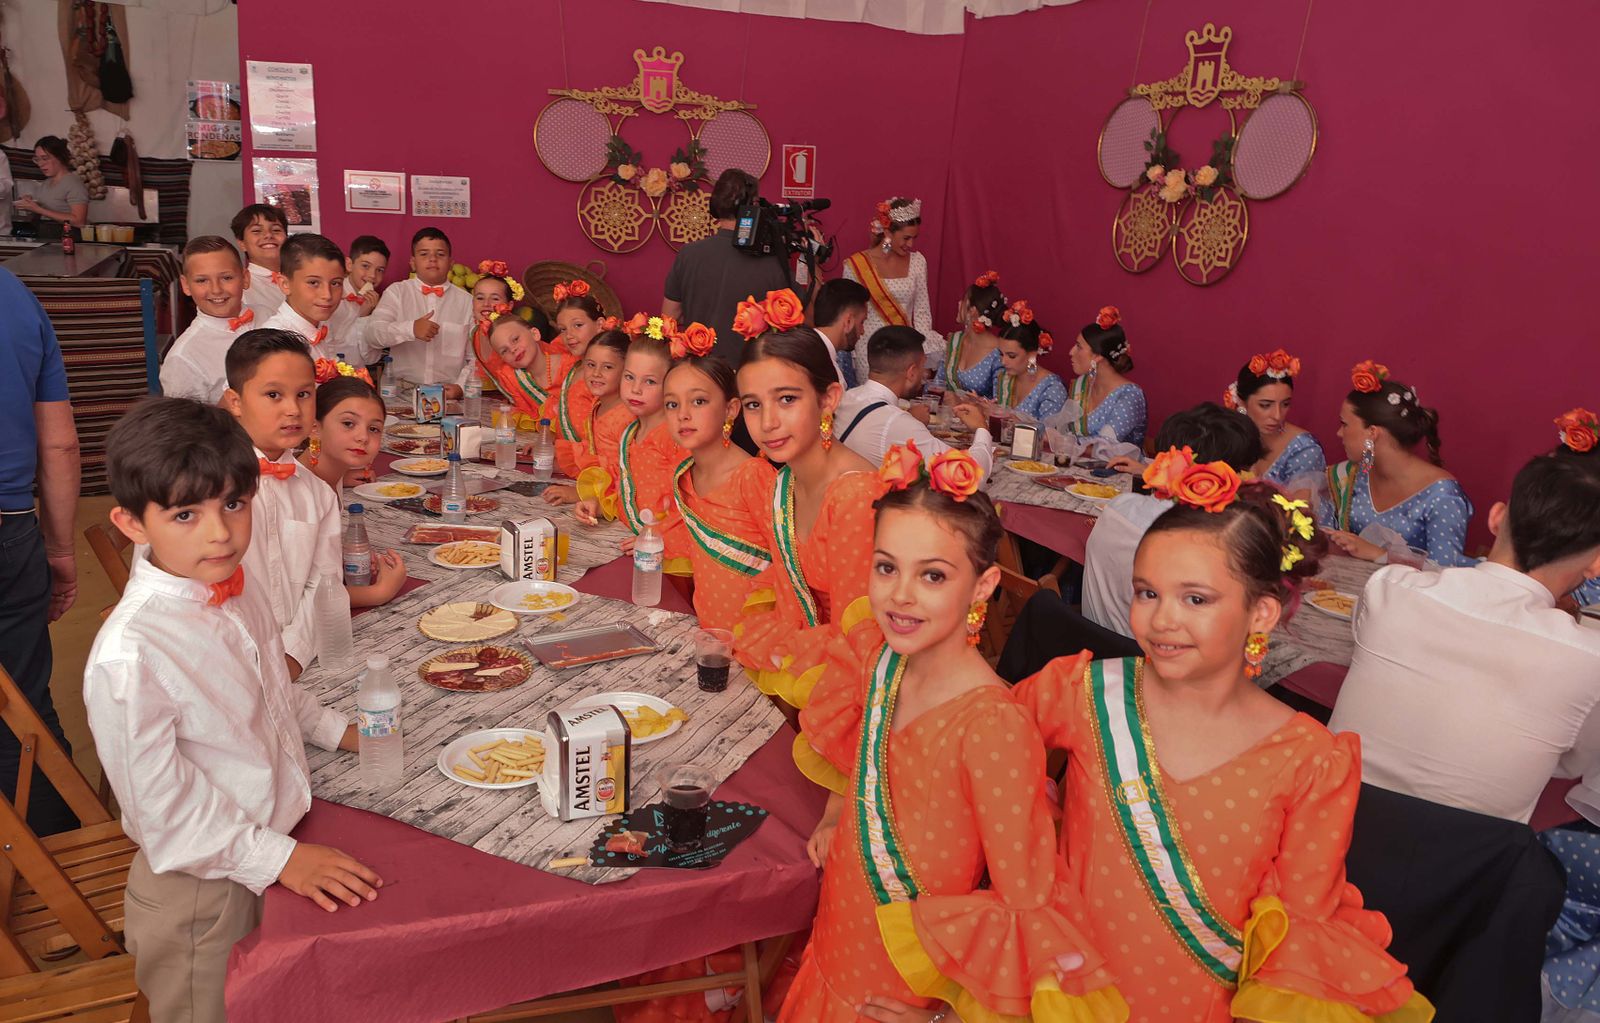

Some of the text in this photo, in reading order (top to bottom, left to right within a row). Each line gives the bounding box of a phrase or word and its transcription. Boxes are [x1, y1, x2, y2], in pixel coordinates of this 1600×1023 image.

[523, 537, 533, 580] AMSTEL
[567, 707, 608, 727] AMSTEL
[574, 746, 591, 811] AMSTEL
